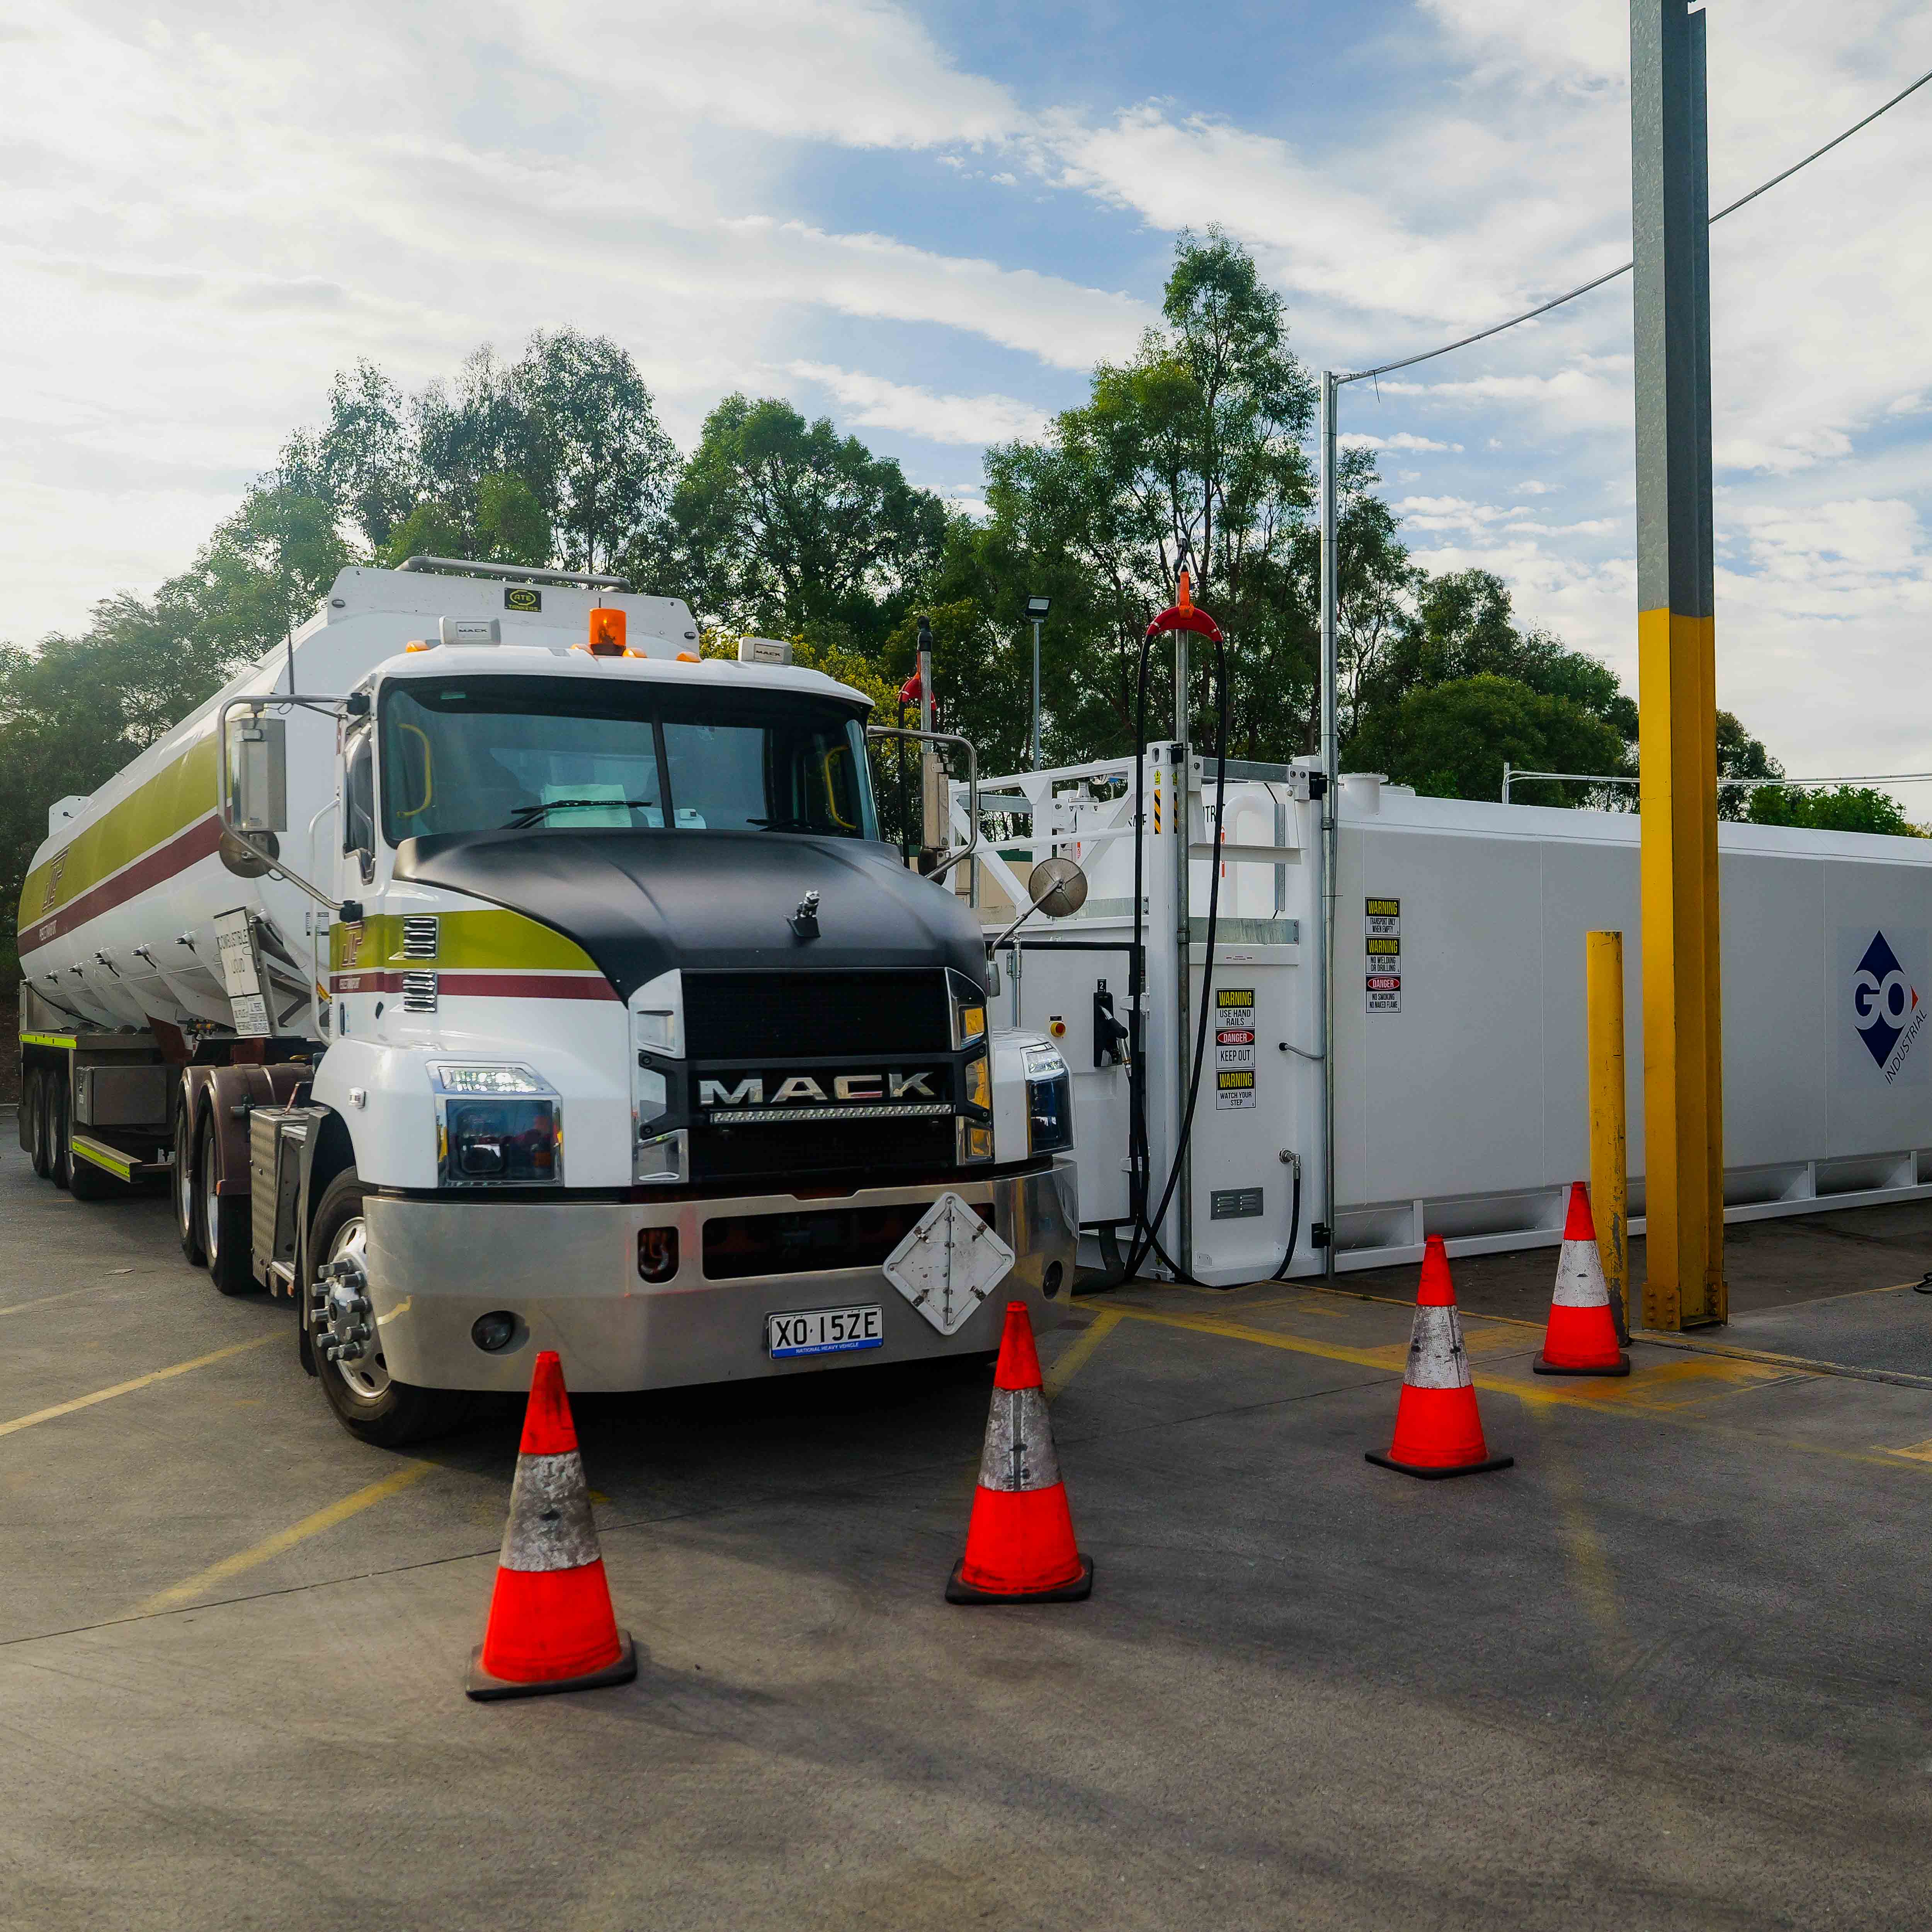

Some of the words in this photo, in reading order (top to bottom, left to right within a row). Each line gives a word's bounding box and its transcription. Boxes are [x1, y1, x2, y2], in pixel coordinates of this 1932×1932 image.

[1368, 900, 1398, 915] WARNING
[1368, 939, 1398, 953] WARNING
[1372, 979, 1394, 988] DANGER
[1219, 992, 1252, 1006] WARNING
[1848, 970, 1910, 1030] GO
[1220, 1009, 1232, 1017] USE
[1233, 1009, 1251, 1017] HAND
[1226, 1018, 1245, 1026] RAILS
[1223, 1033, 1247, 1042] DANGER
[1884, 1009, 1927, 1085] INDUSTRIAL
[1221, 1050, 1237, 1061] KEEP
[1238, 1049, 1250, 1061] OUT
[1219, 1073, 1252, 1088] WARNING
[699, 1072, 937, 1106] MACK
